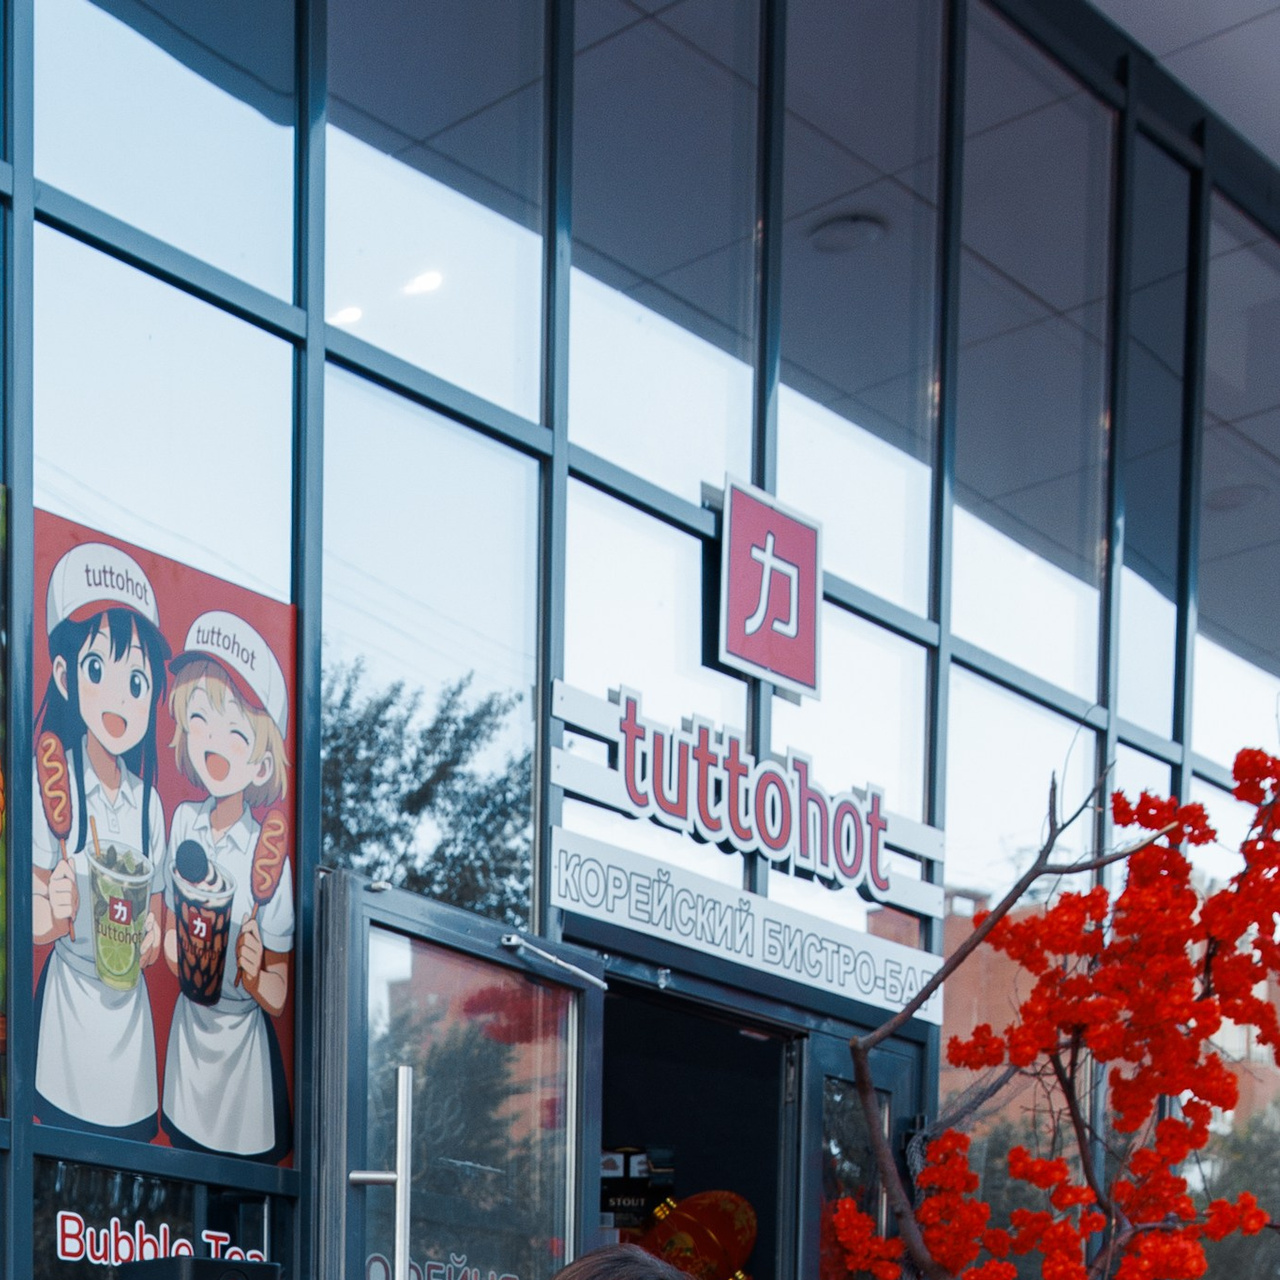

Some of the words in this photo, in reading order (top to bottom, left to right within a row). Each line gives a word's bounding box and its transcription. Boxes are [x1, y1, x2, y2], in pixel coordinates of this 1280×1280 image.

[85, 564, 149, 606] tuttohot
[196, 625, 256, 671] tuttohot
[620, 698, 890, 892] tuttohot
[557, 848, 754, 958] КОРЕЙСКИЙ
[608, 1197, 646, 1208] STOUT
